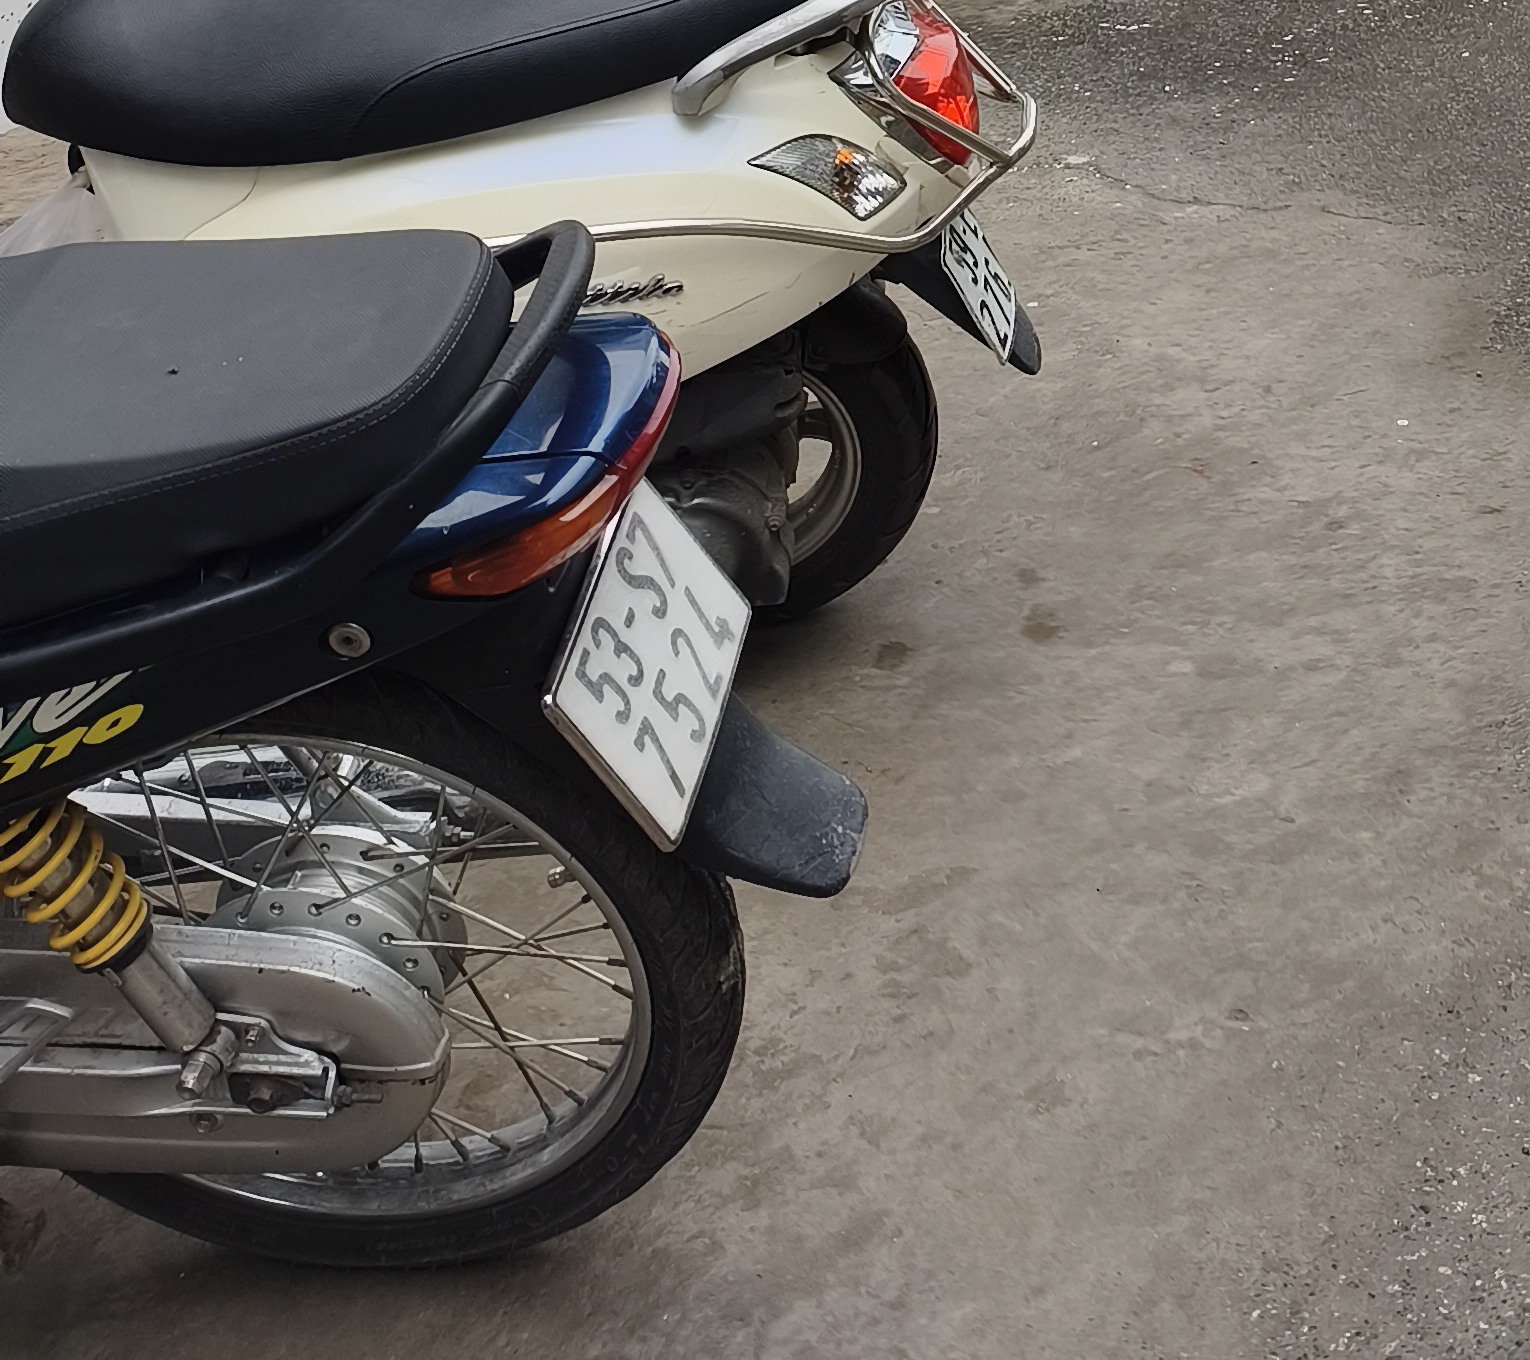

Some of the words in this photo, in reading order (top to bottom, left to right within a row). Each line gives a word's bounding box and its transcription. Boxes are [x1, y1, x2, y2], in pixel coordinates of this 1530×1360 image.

[574, 511, 676, 725] 53-S7
[633, 584, 737, 800] 7524
[0, 703, 145, 785] 110
